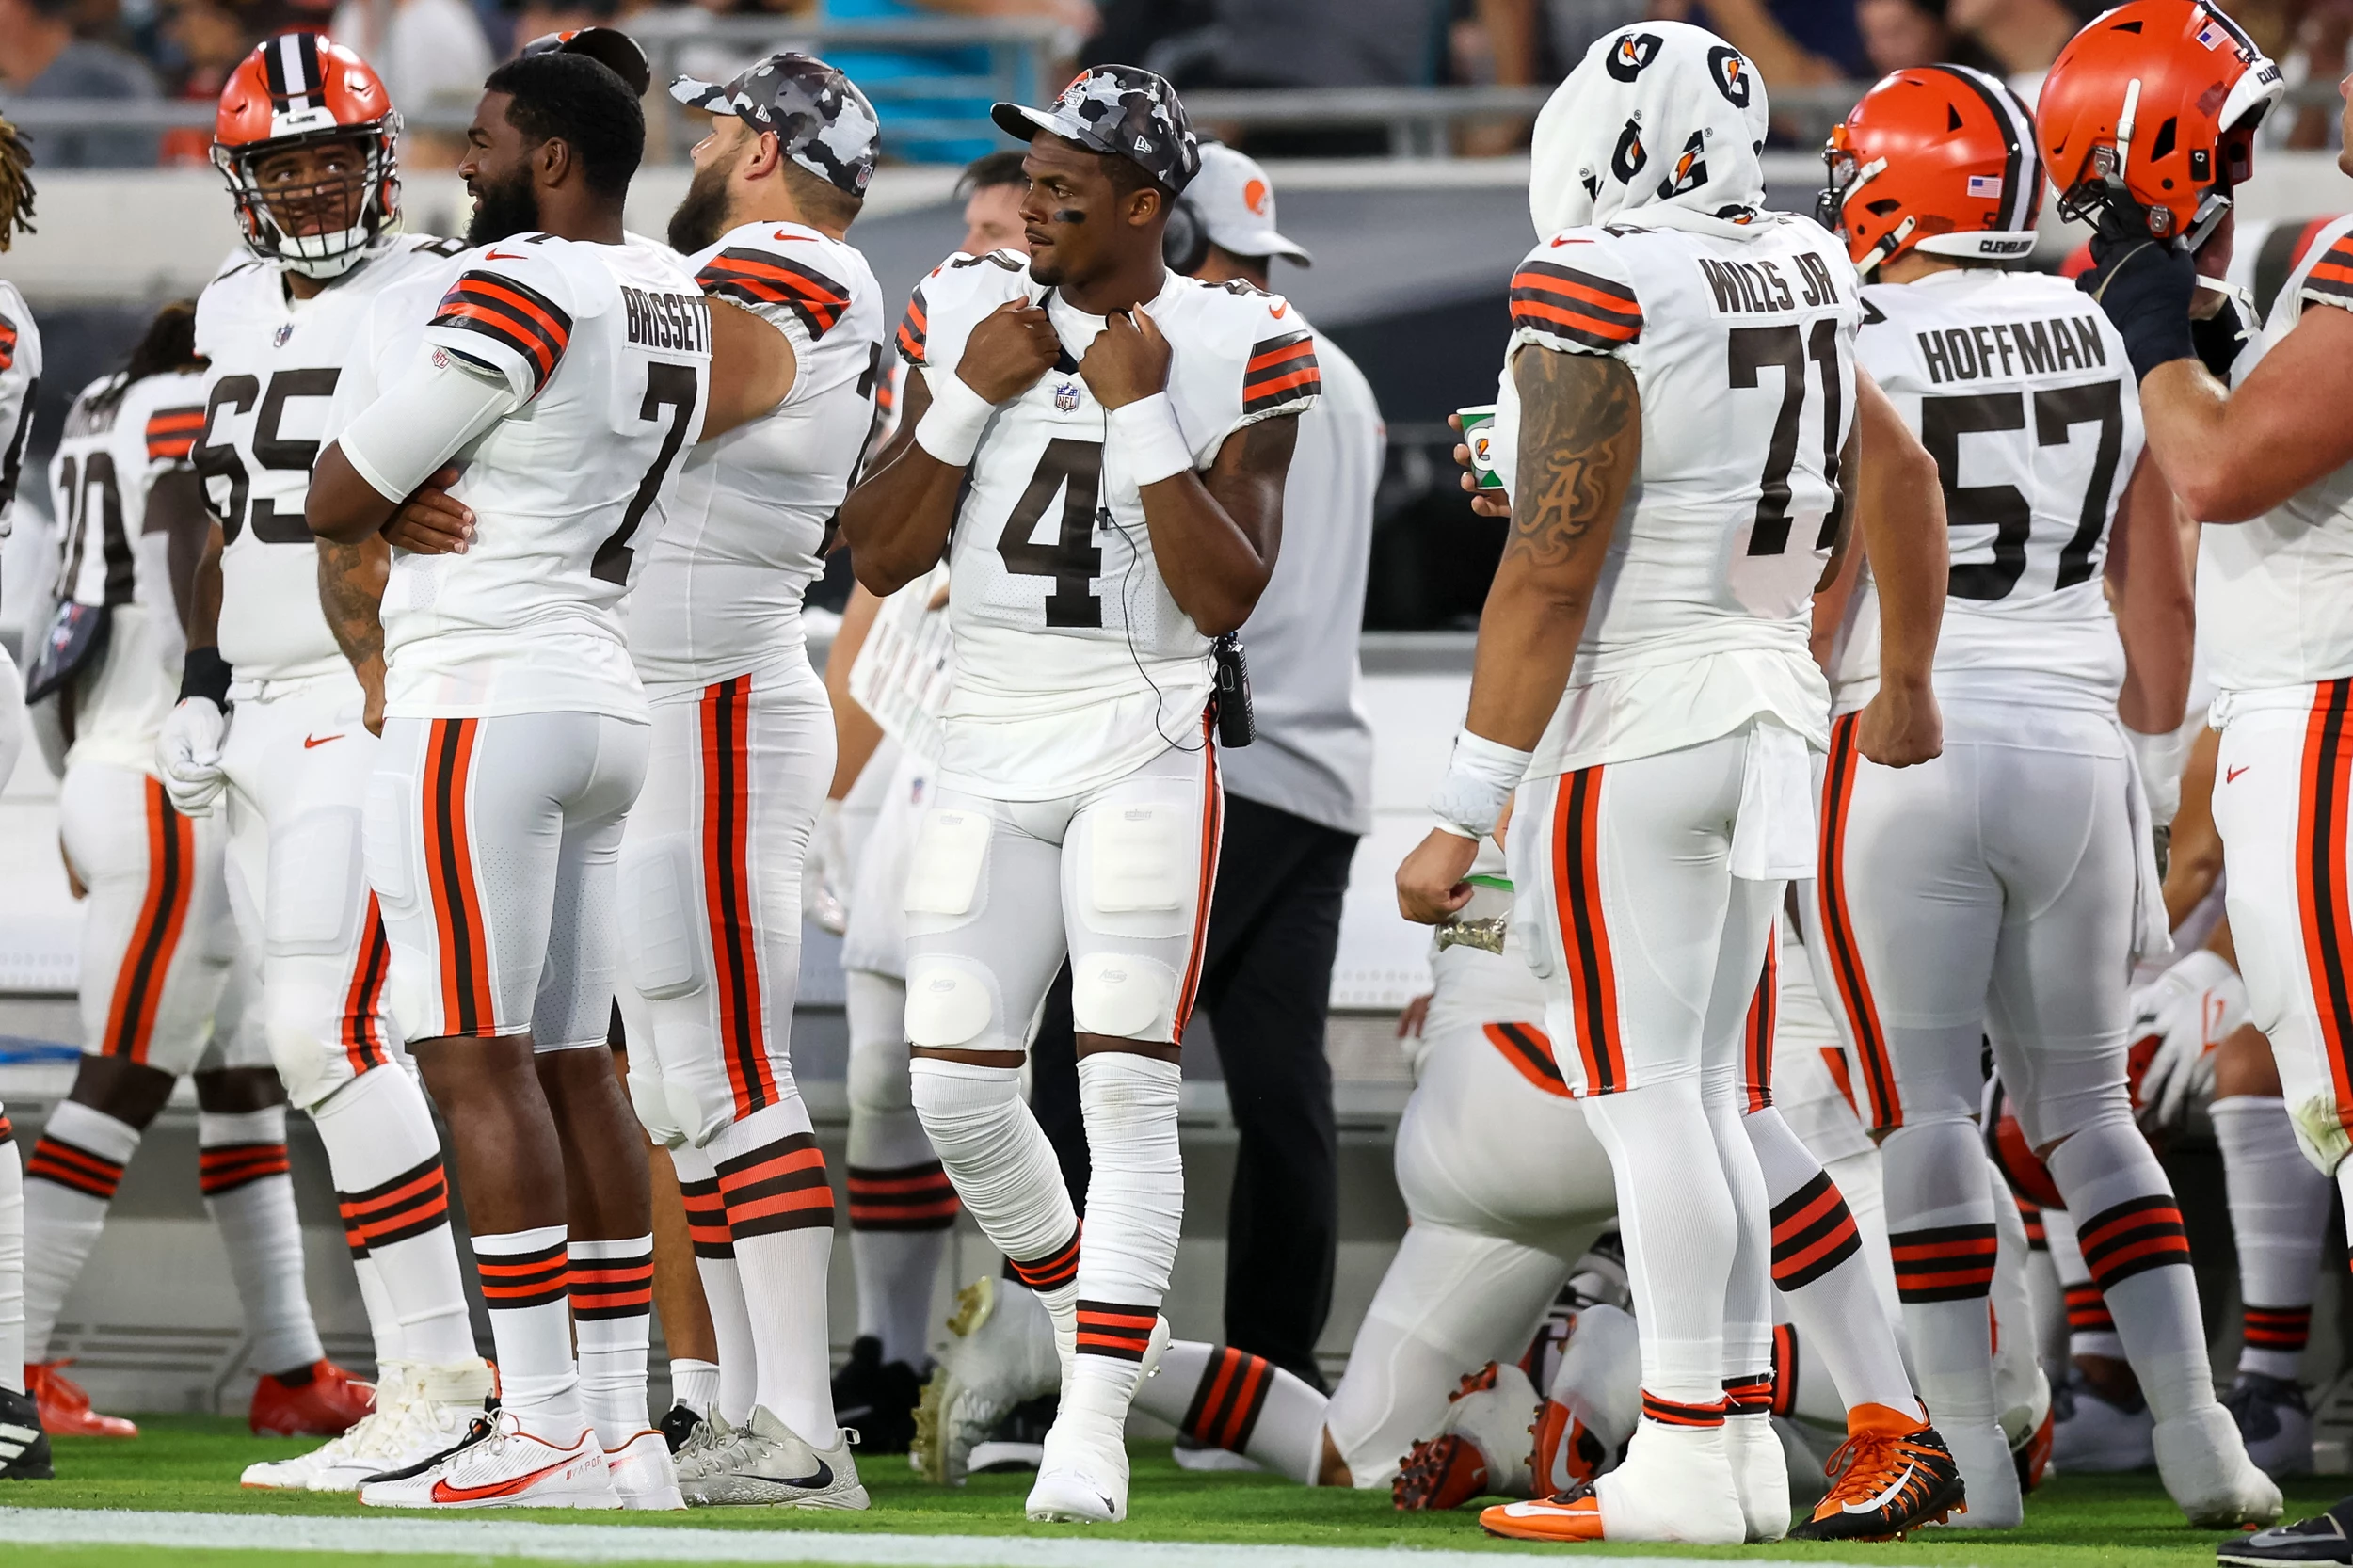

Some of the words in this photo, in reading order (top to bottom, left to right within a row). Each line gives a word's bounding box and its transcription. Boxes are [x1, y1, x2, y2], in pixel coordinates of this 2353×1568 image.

[620, 286, 710, 353] BRISSETT
[1698, 258, 1794, 312] WILLS
[1792, 252, 1839, 307] JR
[435, 351, 448, 367] NFL
[1058, 395, 1075, 408] NFL
[1917, 316, 2106, 383] HOFFMAN
[192, 368, 342, 546] 65
[590, 361, 696, 586] 7
[1728, 318, 1844, 556] 71
[1922, 379, 2122, 600] 57
[997, 437, 1103, 628] 4
